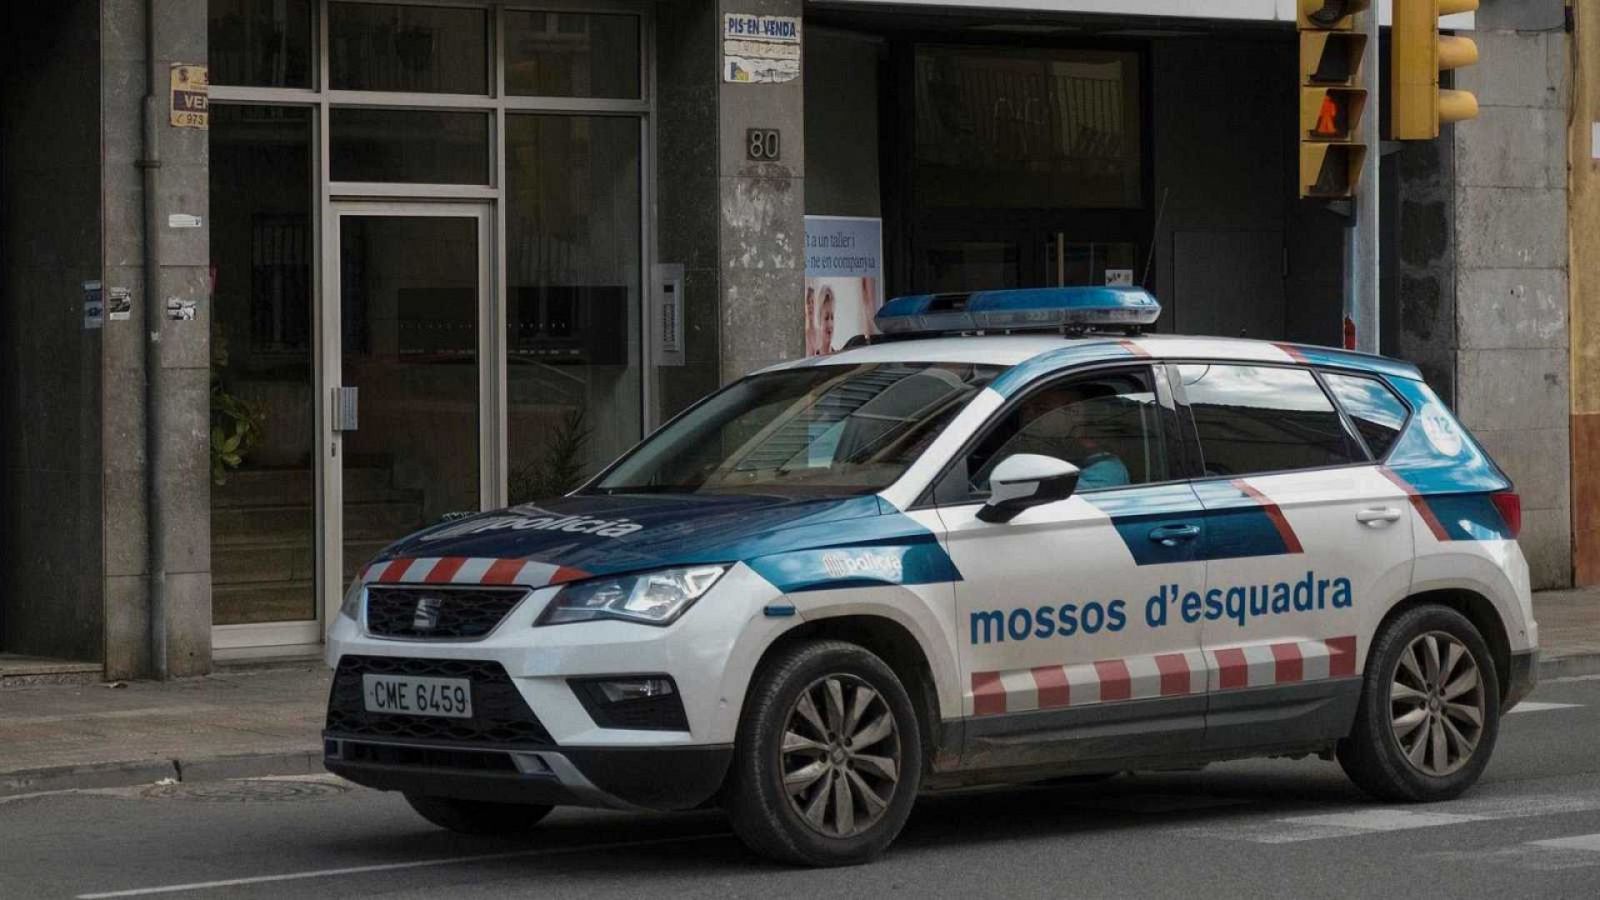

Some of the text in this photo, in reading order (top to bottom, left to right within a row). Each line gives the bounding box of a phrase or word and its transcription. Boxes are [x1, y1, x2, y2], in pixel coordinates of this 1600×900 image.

[729, 17, 797, 37] PIS EN VENDA
[186, 113, 204, 126] 973
[750, 131, 779, 158] 80
[811, 235, 817, 248] a
[818, 235, 829, 249] un
[831, 231, 850, 249] taller
[822, 256, 832, 269] en
[833, 255, 876, 273] companyia
[473, 514, 644, 538] policia
[969, 598, 1127, 645] mossos
[374, 681, 467, 714] CME 6459
